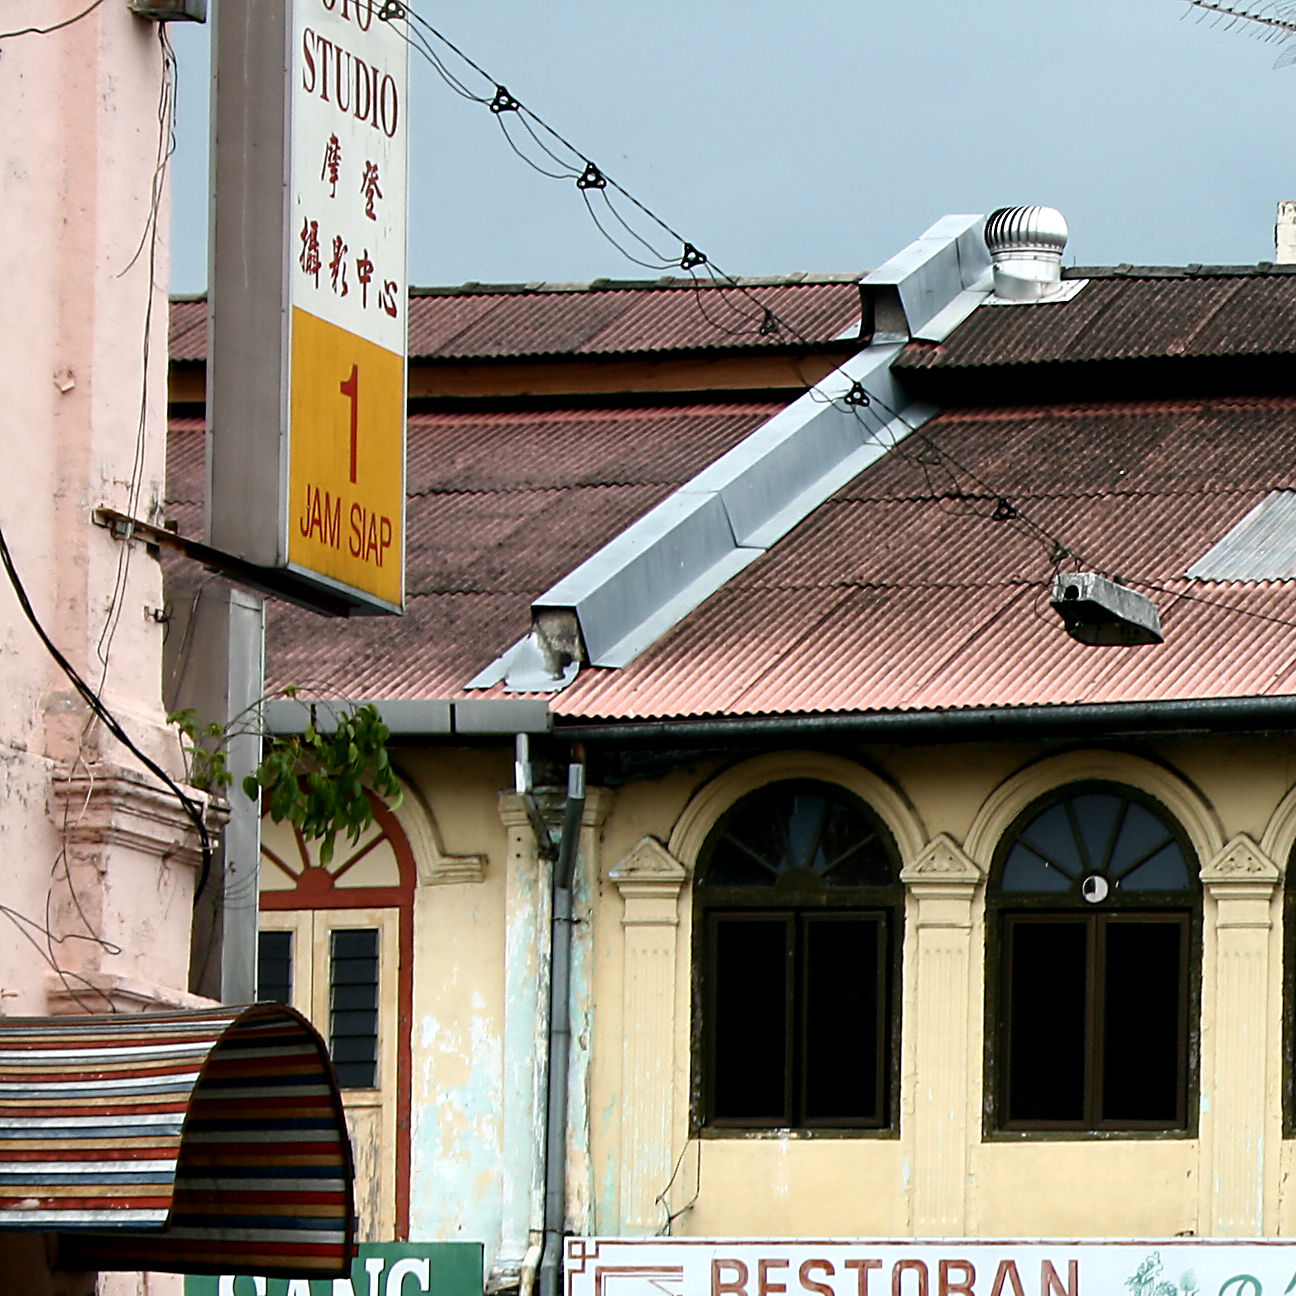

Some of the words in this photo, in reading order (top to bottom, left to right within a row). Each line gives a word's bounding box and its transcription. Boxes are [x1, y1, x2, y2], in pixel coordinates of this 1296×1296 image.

[302, 27, 398, 137] STUDIO
[321, 133, 382, 221] 摩登
[299, 216, 398, 318] 攝影中心
[339, 364, 358, 484] 1
[300, 484, 341, 550] JAM
[349, 503, 392, 567] SIAP
